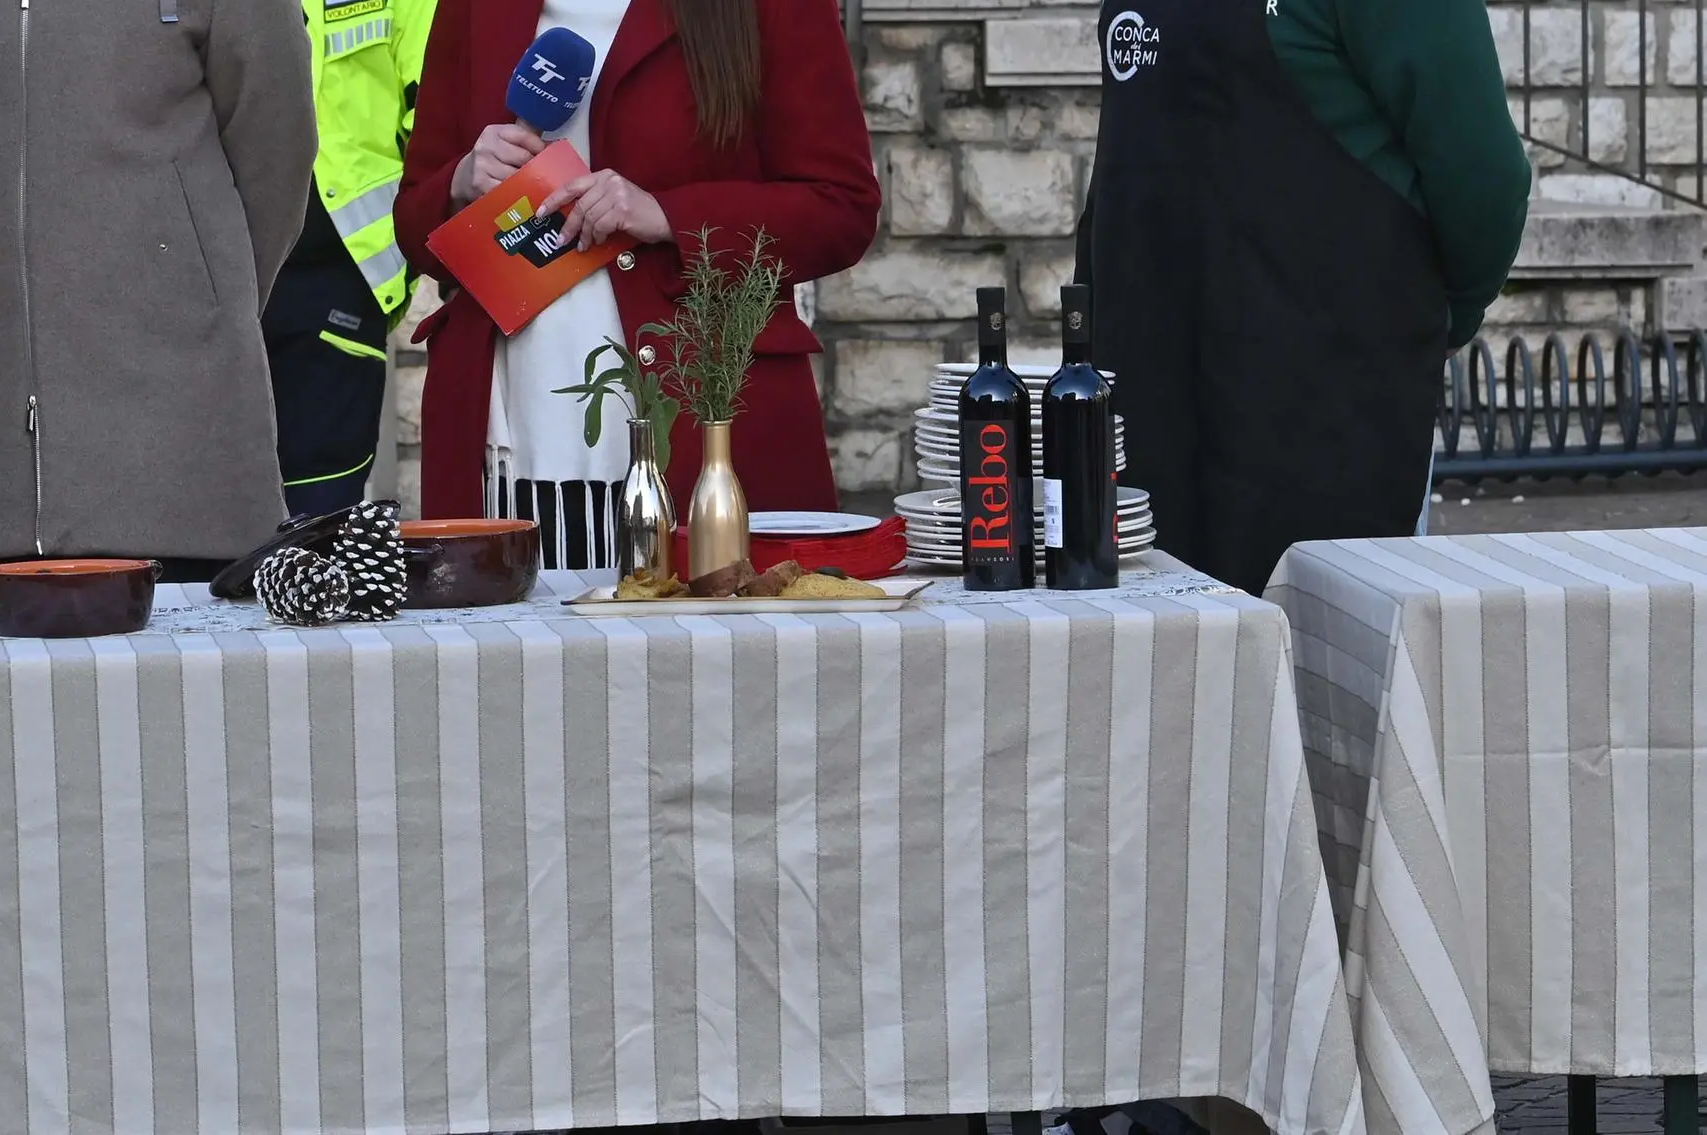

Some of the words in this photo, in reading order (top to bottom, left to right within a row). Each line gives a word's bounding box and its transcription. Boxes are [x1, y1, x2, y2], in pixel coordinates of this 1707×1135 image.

[326, 0, 382, 18] VOLONTARIO
[1114, 26, 1161, 43] CONCA
[1113, 50, 1158, 66] MARMI
[515, 74, 559, 103] TELETUTTO
[507, 208, 522, 224] IN
[499, 225, 531, 250] PIAZZA
[968, 424, 1011, 553] Rebo
